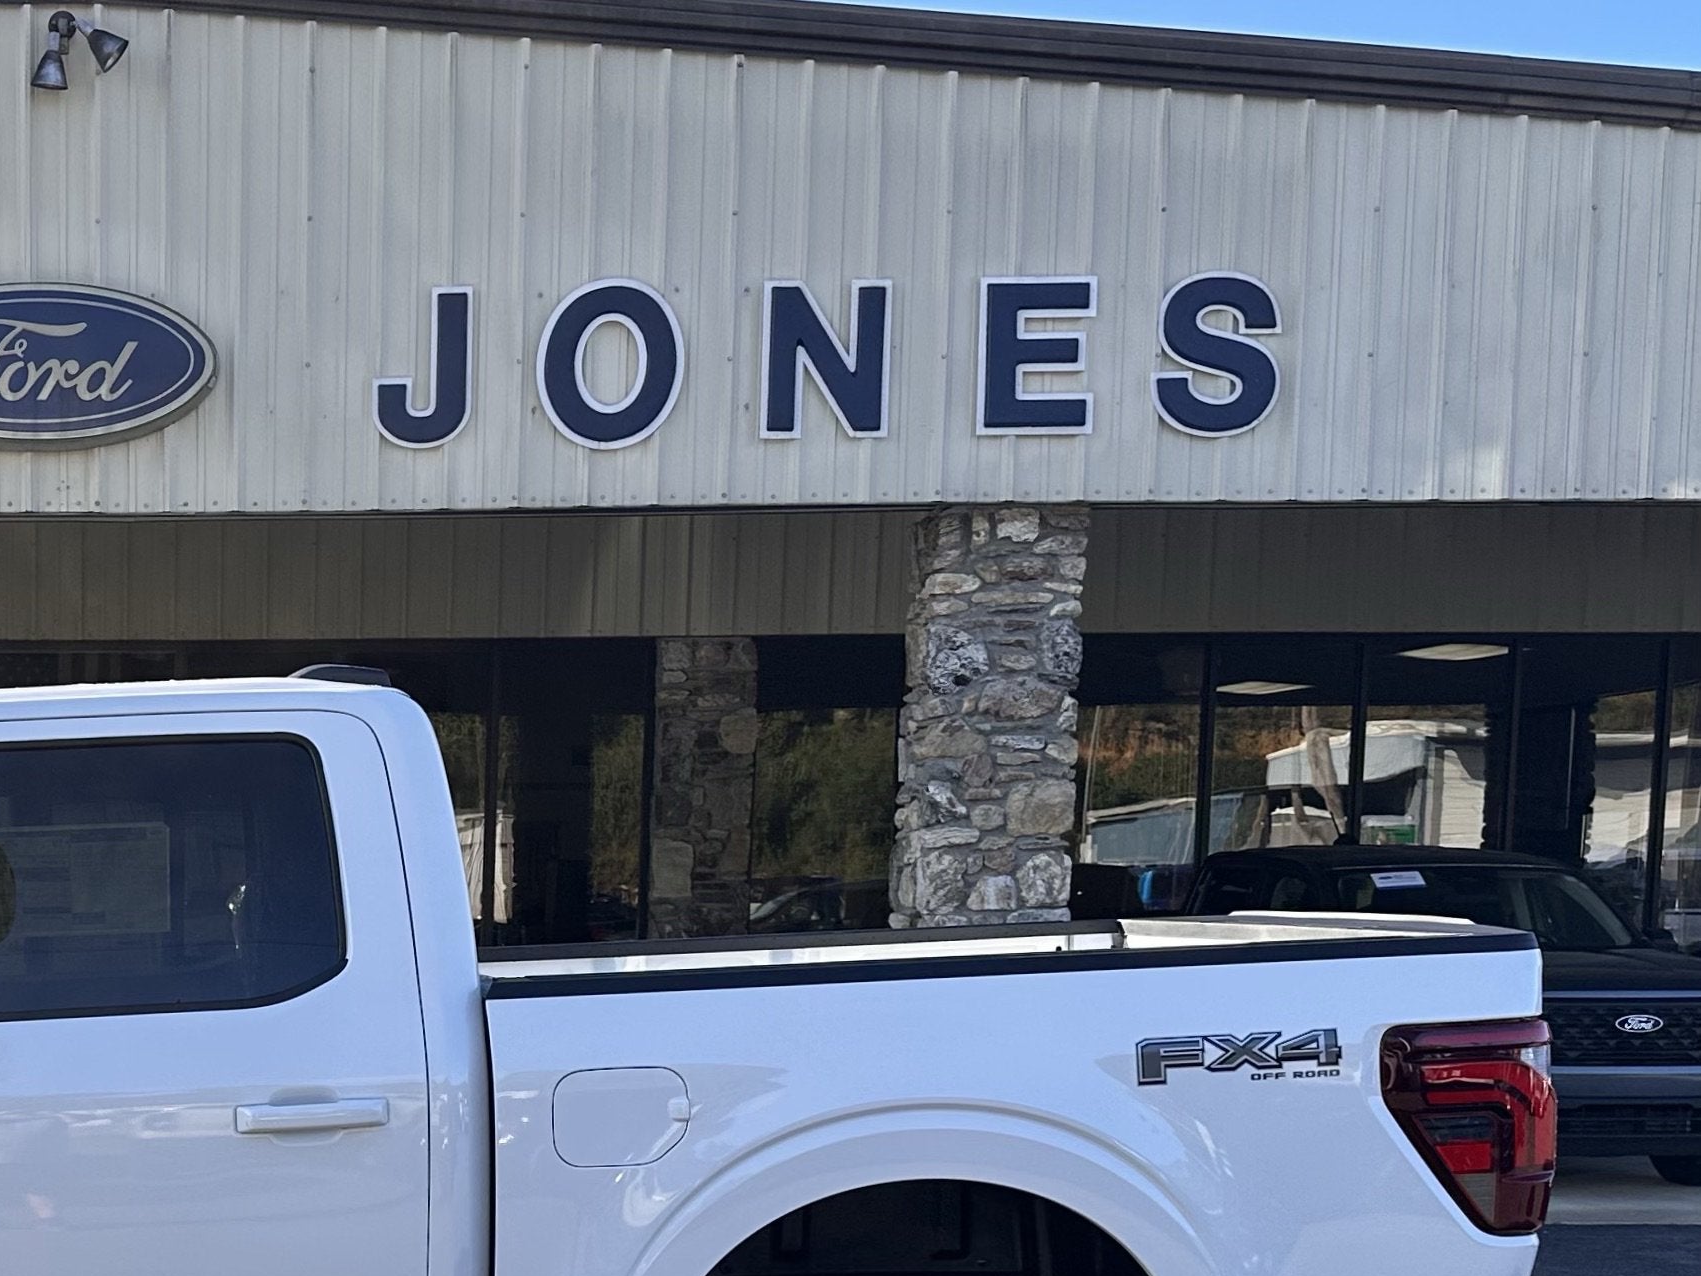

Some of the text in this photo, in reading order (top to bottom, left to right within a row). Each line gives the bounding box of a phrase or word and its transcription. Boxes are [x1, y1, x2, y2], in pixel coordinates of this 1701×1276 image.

[372, 271, 1283, 450] JONES
[1135, 1027, 1342, 1087] FX4
[1250, 1068, 1341, 1081] OFF ROAD
